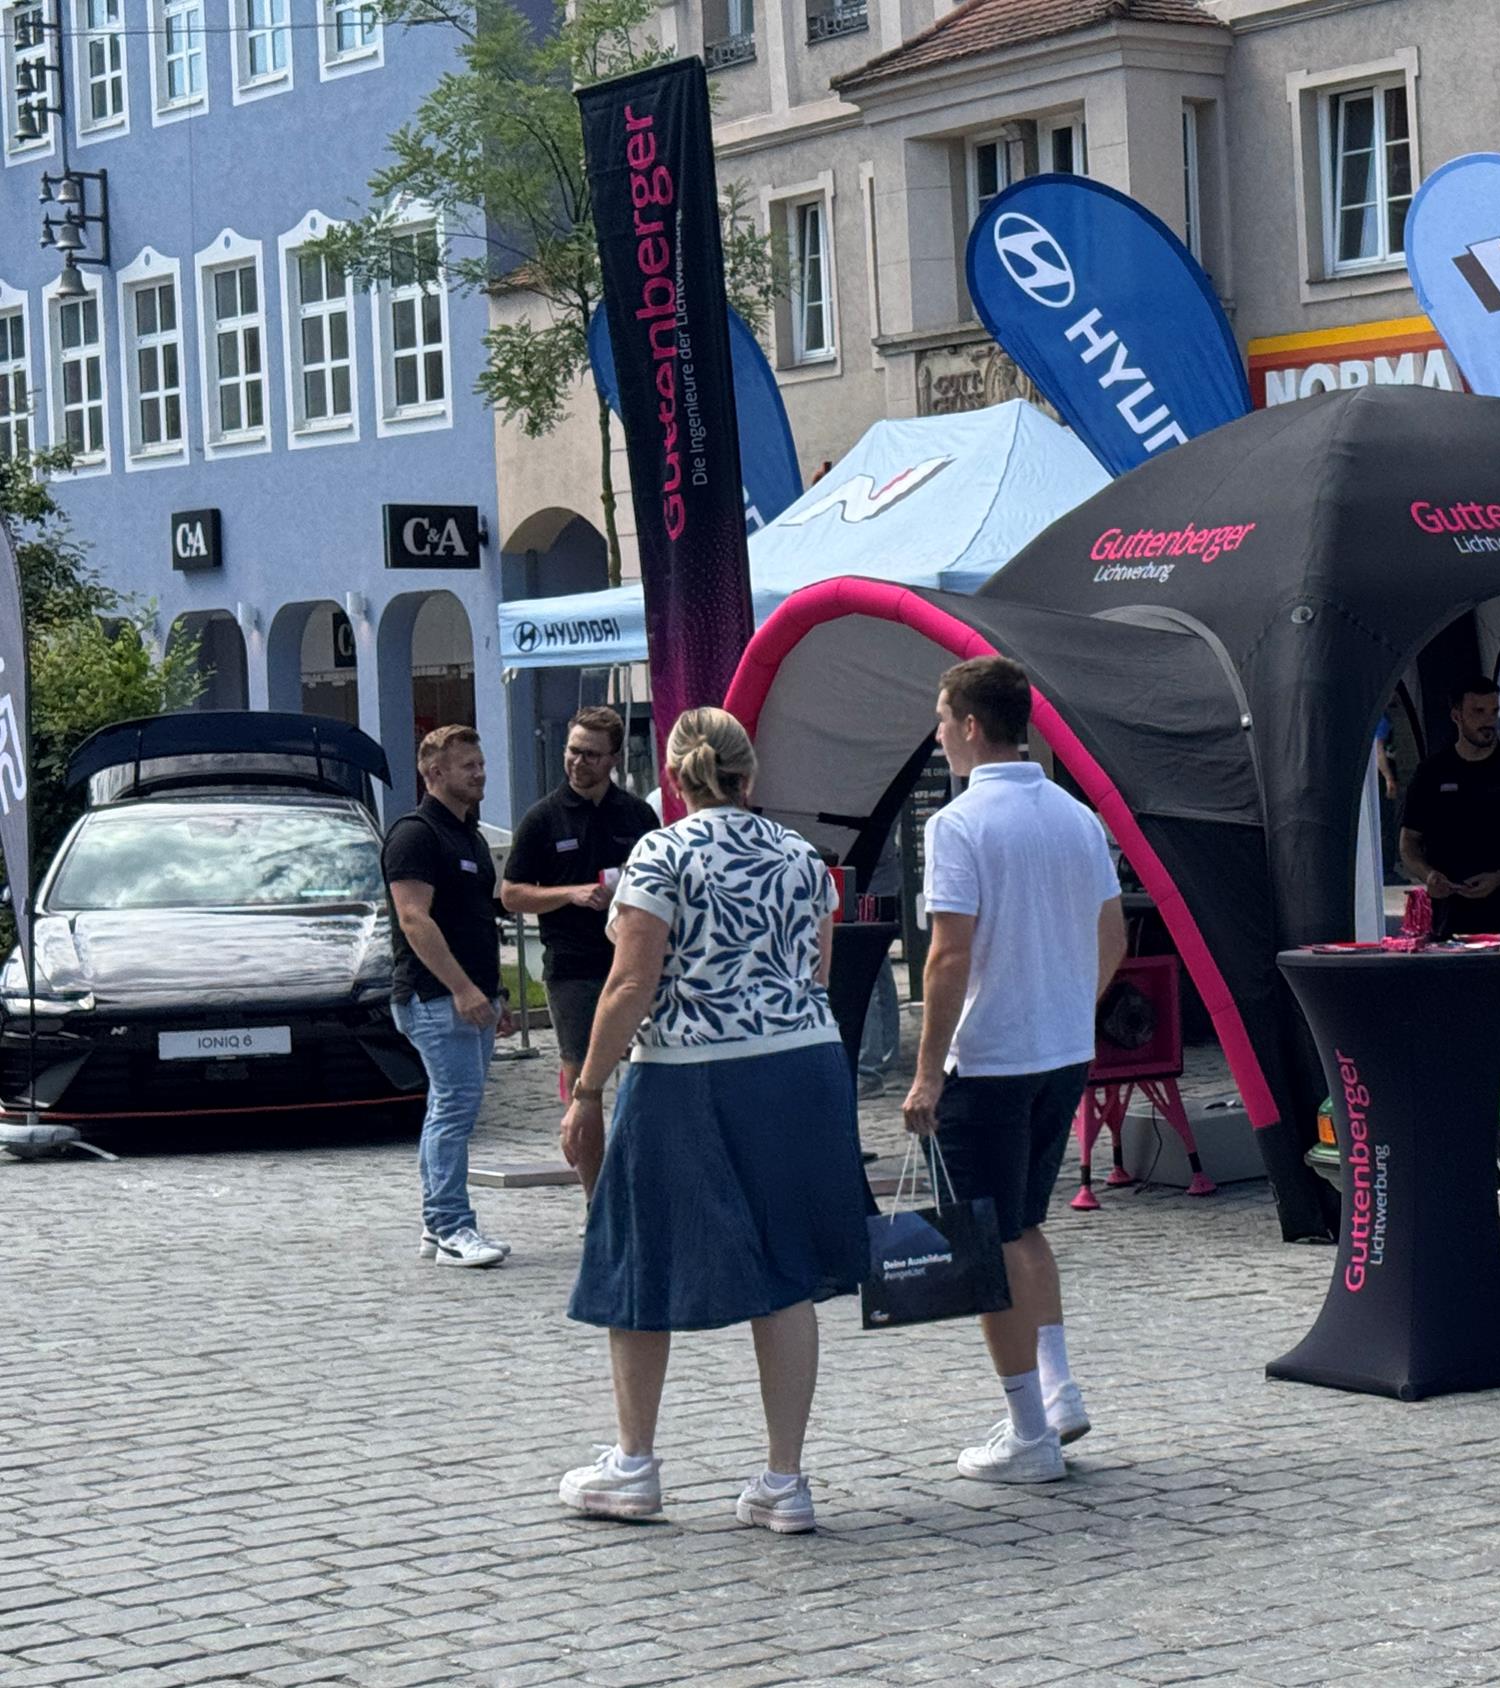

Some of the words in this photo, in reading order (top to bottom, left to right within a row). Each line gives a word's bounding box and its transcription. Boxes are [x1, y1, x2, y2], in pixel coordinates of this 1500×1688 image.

[624, 105, 686, 541] Guttenberger
[678, 331, 692, 360] der
[682, 363, 707, 454] Ingenieure
[693, 458, 708, 486] Die
[176, 521, 208, 558] C&A
[403, 517, 470, 557] C&A
[1090, 522, 1256, 563] Guttenberger
[1093, 561, 1175, 583] Lichtwerbung
[543, 617, 621, 647] HYUNDAI
[198, 1035, 239, 1049] IONIQ
[243, 1034, 253, 1047] 6
[1335, 1048, 1370, 1292] Guttenberger
[1370, 1144, 1391, 1266] Lichtwerbung
